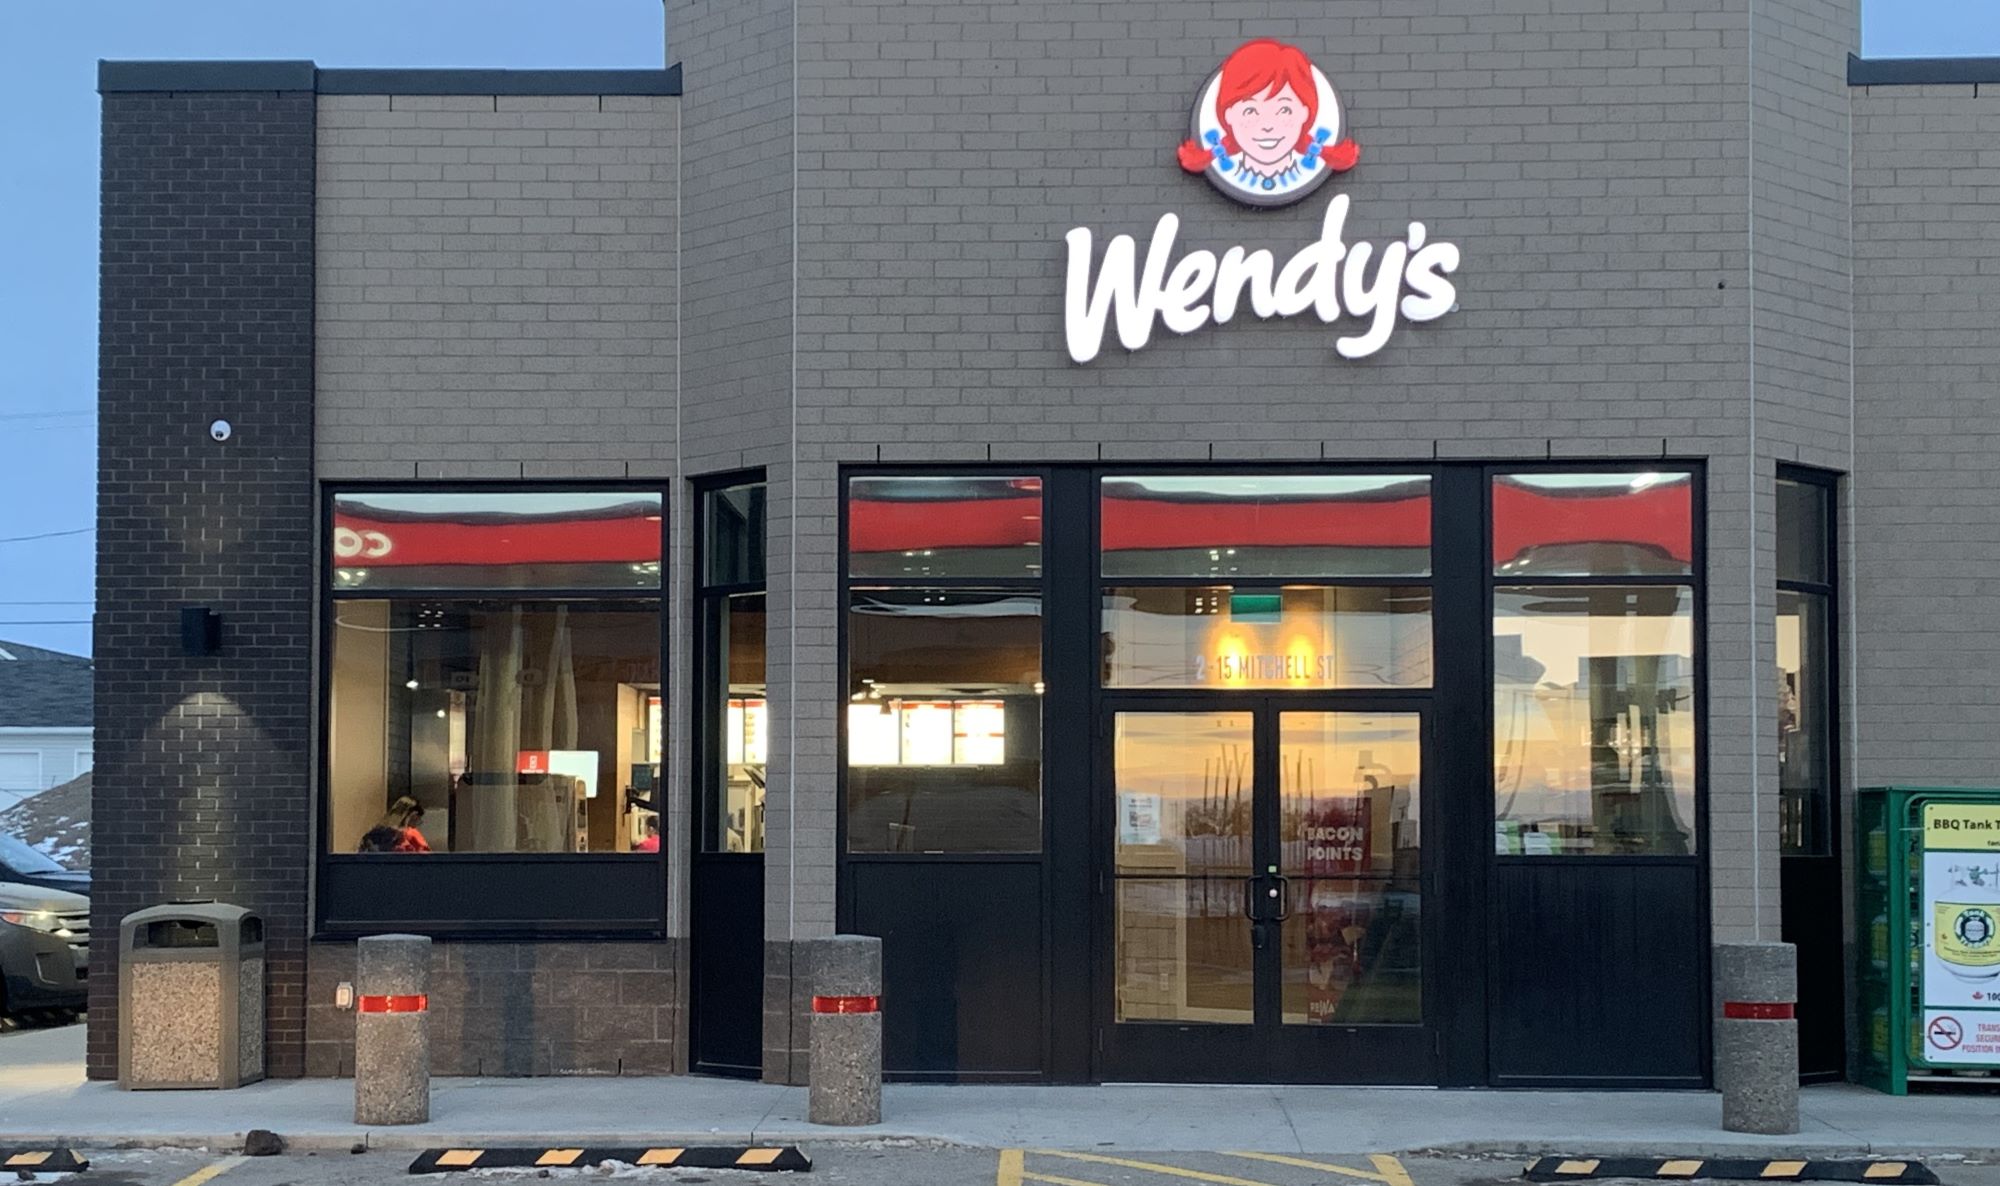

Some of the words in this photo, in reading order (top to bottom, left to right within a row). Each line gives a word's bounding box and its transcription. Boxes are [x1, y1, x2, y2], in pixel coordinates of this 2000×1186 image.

[1065, 194, 1460, 362] Wendy's
[1238, 655, 1310, 680] MITCHELL
[1317, 655, 1333, 680] ST
[1933, 819, 1960, 831] BBQ
[1962, 819, 1993, 830] Tank
[1307, 827, 1364, 841] BACON
[1307, 847, 1363, 861] POINTS
